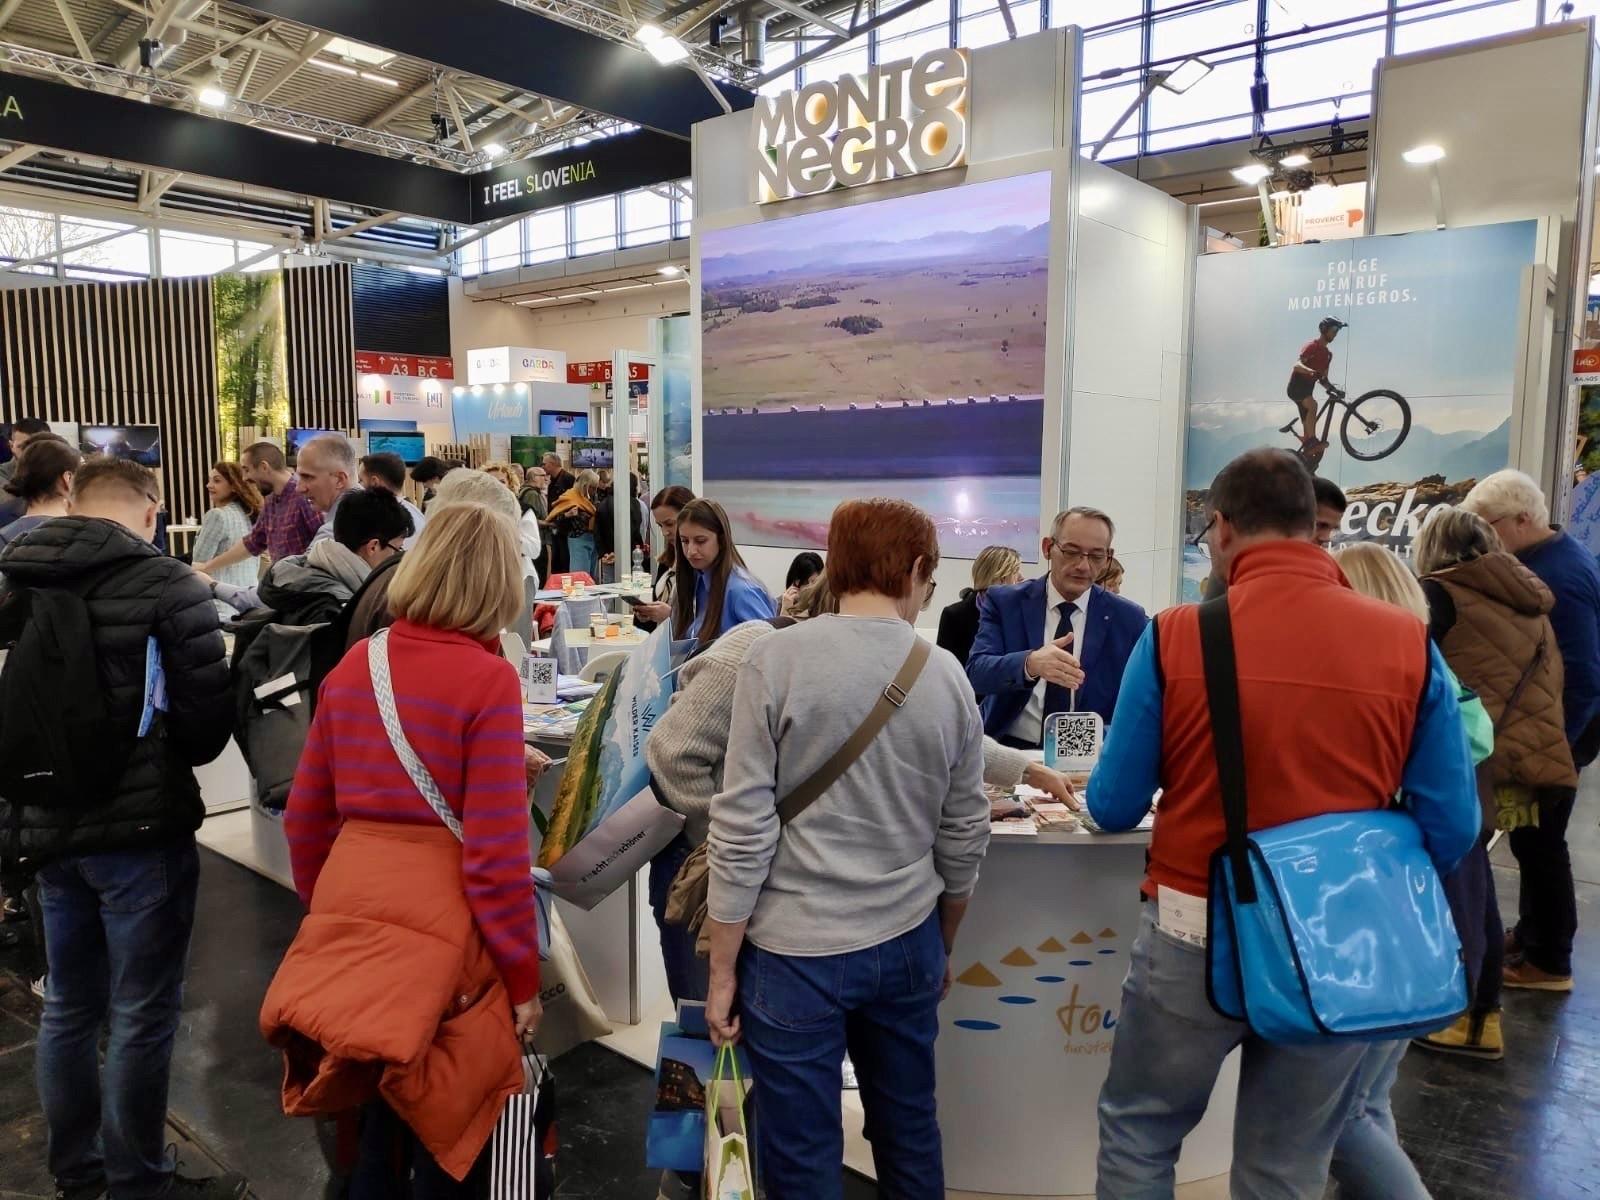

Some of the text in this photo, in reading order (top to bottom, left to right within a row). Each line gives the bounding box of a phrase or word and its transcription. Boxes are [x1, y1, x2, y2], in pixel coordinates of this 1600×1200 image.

[0, 95, 24, 120] A
[484, 160, 596, 205] I FEEL SLOVENIA
[1305, 215, 1345, 225] PROVENCE
[1328, 258, 1378, 275] FOLGE
[1316, 273, 1388, 292] DEM RUF
[1288, 288, 1417, 311] MONTENEGROS.
[391, 363, 409, 376] A3
[522, 358, 555, 369] GARDA
[631, 694, 640, 758] WILDER KAISER
